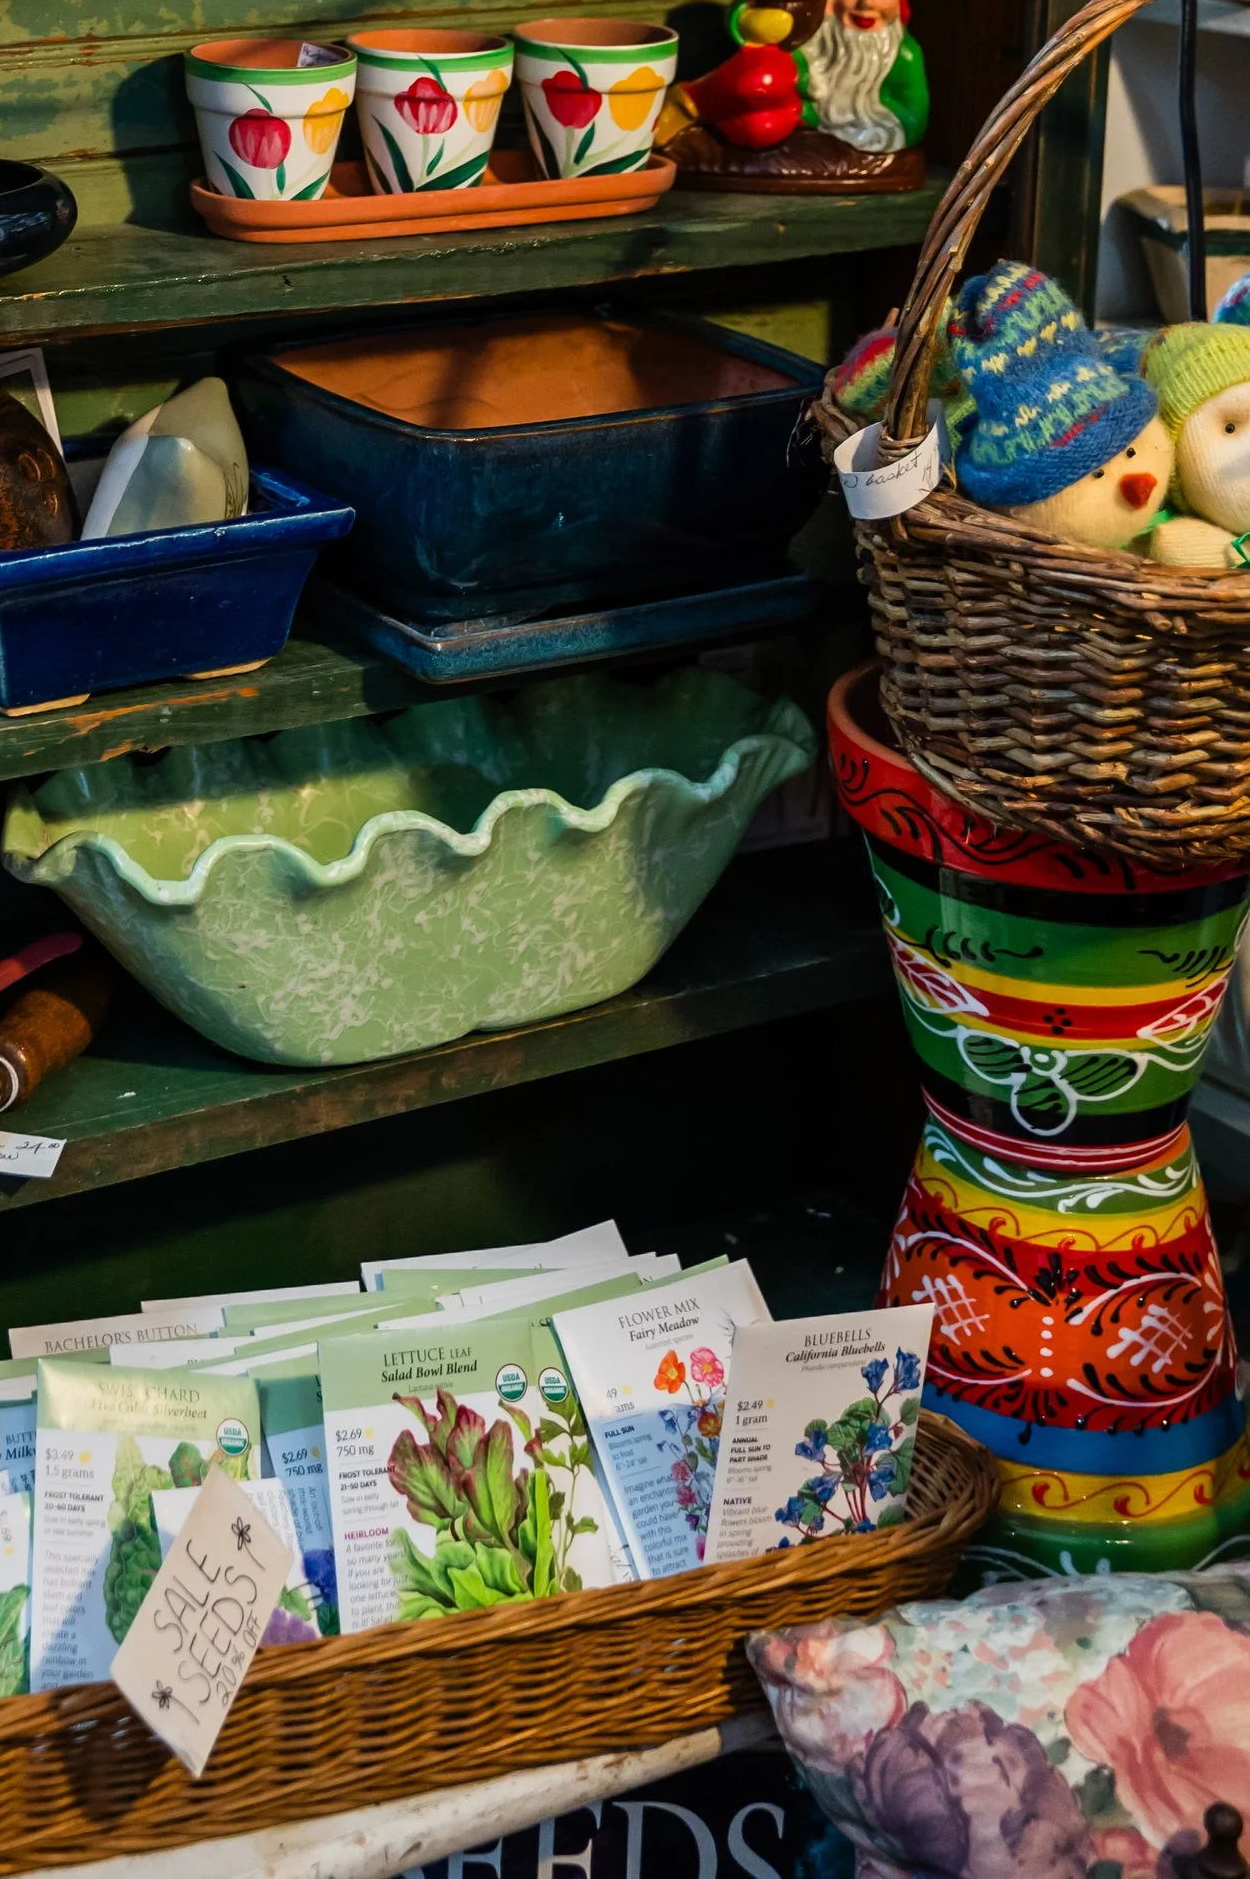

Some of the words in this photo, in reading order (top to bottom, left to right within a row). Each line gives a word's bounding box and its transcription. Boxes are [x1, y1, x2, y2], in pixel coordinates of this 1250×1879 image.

[618, 1305, 672, 1329] FLOWER
[675, 1298, 700, 1315] MIX
[629, 1325, 656, 1341] Fairy
[659, 1317, 699, 1334] Meadow
[45, 1331, 131, 1354] BACHELOR'S
[137, 1322, 198, 1343] BUTTON
[804, 1328, 871, 1347] BLUEBELLS
[383, 1347, 446, 1367] LETTUCE
[450, 1347, 473, 1360] LEAF
[785, 1348, 838, 1364] California
[841, 1341, 886, 1357] Bluebells
[381, 1369, 413, 1383] Salad
[415, 1365, 443, 1379] Bowl
[446, 1360, 478, 1374] Blend
[502, 1372, 521, 1382] USDA
[737, 1399, 764, 1412] $2.49
[743, 1413, 768, 1426] gram
[335, 1428, 362, 1442] $2.69
[604, 1428, 620, 1439] FULL
[622, 1426, 635, 1435] SUN
[45, 1449, 74, 1461] $3.49
[336, 1445, 356, 1458] 750
[358, 1443, 375, 1457] mg
[730, 1445, 746, 1454] FULL
[763, 1443, 771, 1451] TO
[282, 1449, 308, 1464] $2.69
[729, 1455, 746, 1463] PART
[747, 1454, 768, 1463] SHADE
[45, 1465, 59, 1476] 1.5
[62, 1467, 94, 1479] grams
[286, 1465, 305, 1477] 750
[307, 1463, 323, 1475] mg
[339, 1469, 361, 1480] FROST
[362, 1465, 396, 1477] TOLERANT
[624, 1480, 655, 1494] Imagine
[656, 1474, 673, 1485] what
[44, 1491, 67, 1499] FROST
[69, 1492, 104, 1502] TOLERANT
[723, 1497, 753, 1505] NATIVE
[632, 1503, 659, 1519] garden
[661, 1501, 674, 1512] you
[723, 1507, 750, 1516] Vibrant
[751, 1506, 768, 1515] blue
[637, 1516, 657, 1528] could
[659, 1511, 677, 1522] have
[720, 1517, 748, 1527] flowers
[749, 1515, 772, 1524] bloom
[344, 1527, 389, 1541] HEIRLOOM
[640, 1529, 656, 1541] with
[658, 1525, 671, 1535] this
[728, 1528, 752, 1540] spring
[346, 1544, 352, 1553] A
[353, 1542, 383, 1553] favorite
[385, 1537, 397, 1549] for
[644, 1538, 673, 1552] colorful
[674, 1534, 687, 1544] mix
[717, 1538, 753, 1550] providing
[648, 1552, 665, 1563] that
[673, 1546, 689, 1557] sure
[652, 1567, 661, 1576] to
[661, 1560, 686, 1574] attract
[349, 1579, 379, 1591] looking
[381, 1576, 393, 1587] for
[393, 1573, 409, 1586] just
[154, 1539, 220, 1654] SALE
[243, 1609, 262, 1648] OFF
[178, 1566, 257, 1707] SEEDS
[42, 1642, 78, 1654] dazzling
[41, 1669, 61, 1679] your
[63, 1670, 94, 1680] garden
